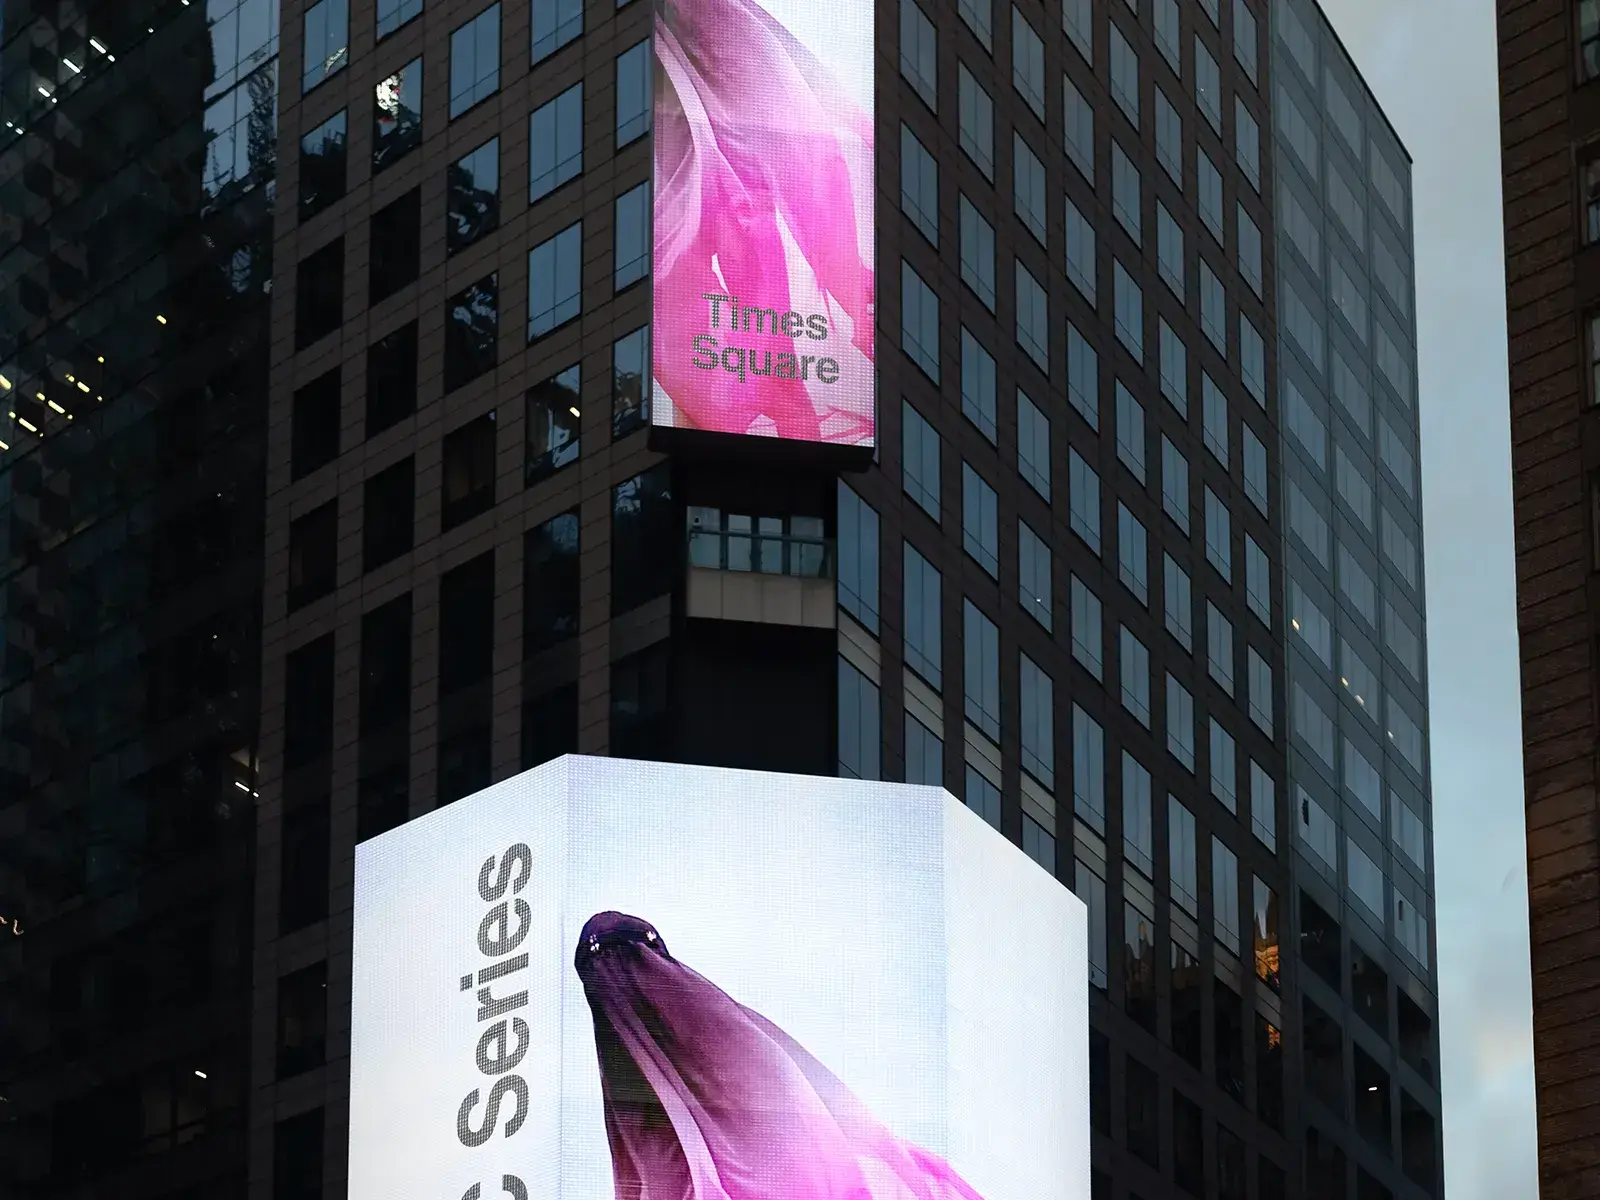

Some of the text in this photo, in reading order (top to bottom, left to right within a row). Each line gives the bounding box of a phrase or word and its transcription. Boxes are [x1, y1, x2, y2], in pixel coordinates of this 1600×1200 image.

[702, 292, 828, 341] Times
[692, 333, 840, 384] Square
[456, 842, 533, 1149] Series
